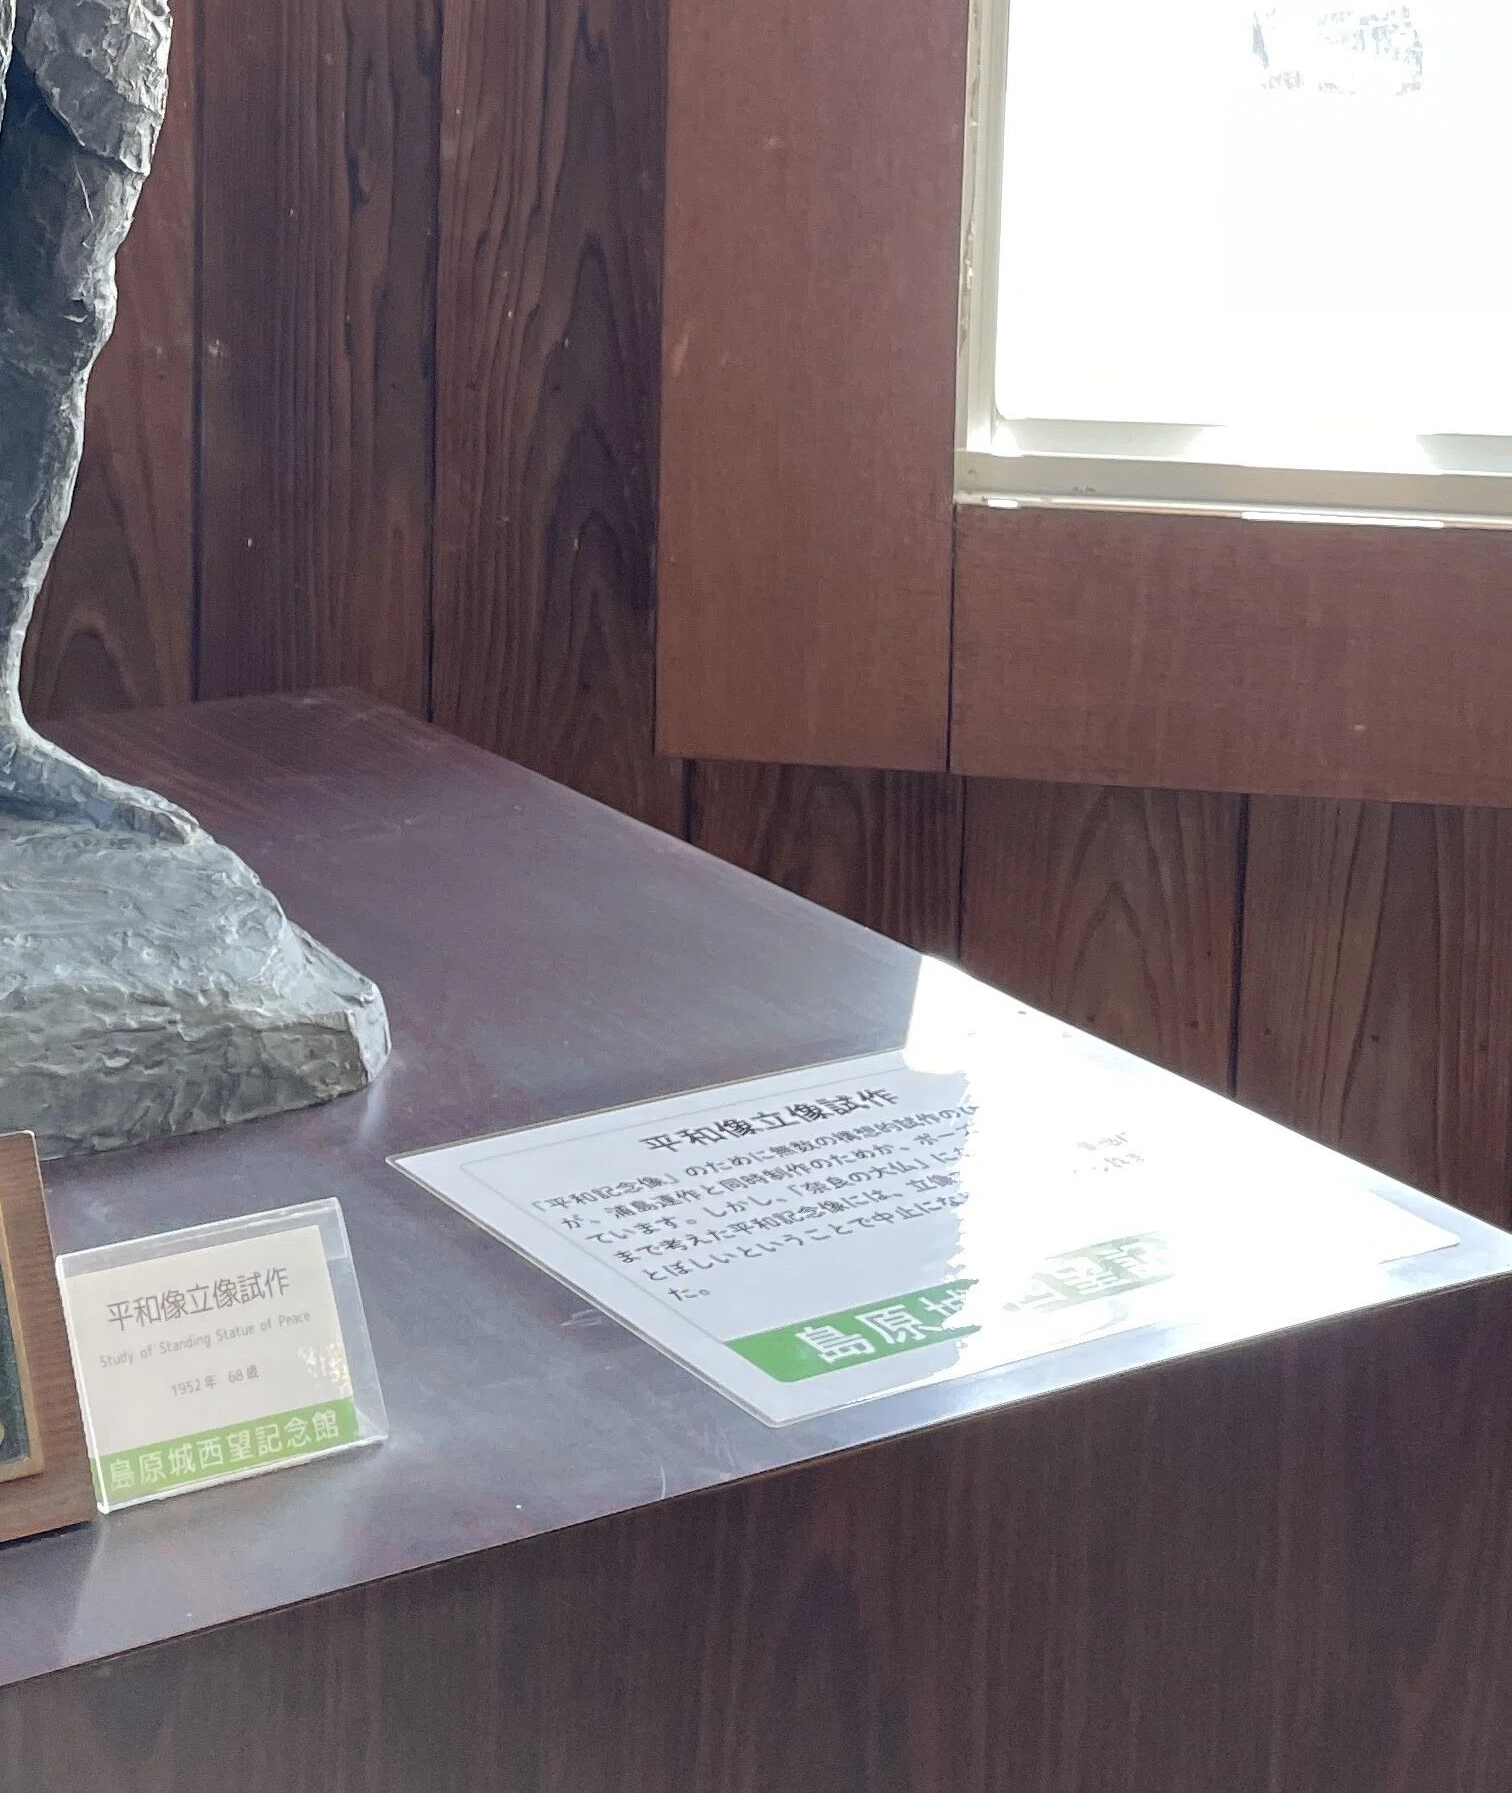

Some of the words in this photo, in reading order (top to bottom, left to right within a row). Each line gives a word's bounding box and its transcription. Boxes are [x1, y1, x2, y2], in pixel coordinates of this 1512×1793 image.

[639, 1089, 899, 1153] 平和像立像試作
[106, 1266, 290, 1332] 平和像立像試作
[667, 1287, 710, 1302] た。
[99, 1349, 135, 1368] Study
[140, 1344, 152, 1358] of
[159, 1333, 212, 1355] Standing
[216, 1323, 254, 1342] Statue
[260, 1318, 272, 1332] of
[278, 1311, 311, 1327] Peace
[171, 1375, 217, 1397] 1952年
[227, 1364, 260, 1384] 68歳
[108, 1409, 340, 1491] 島原城西望記念館
